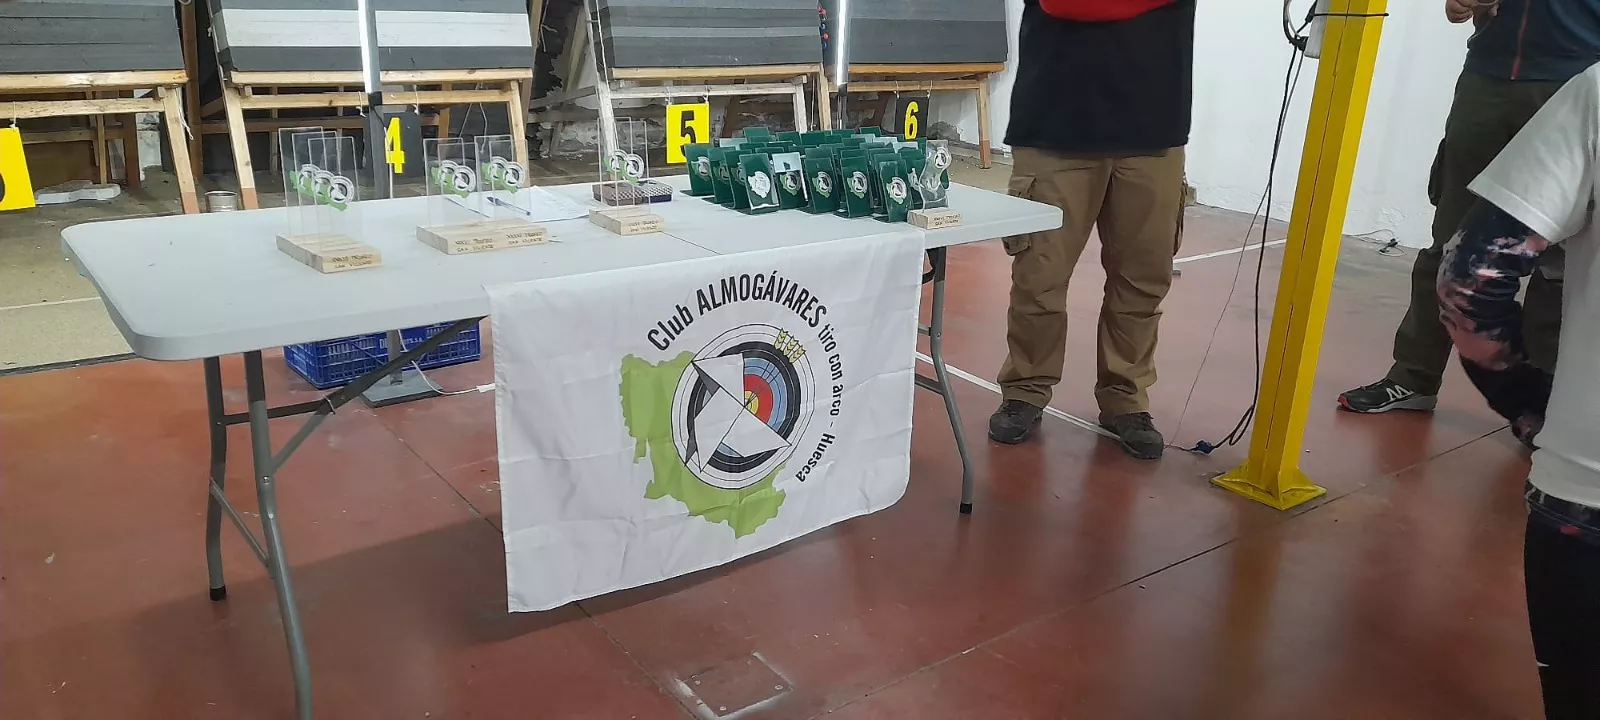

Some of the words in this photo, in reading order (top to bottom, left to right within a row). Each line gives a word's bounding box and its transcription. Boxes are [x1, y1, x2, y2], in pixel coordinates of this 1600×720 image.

[680, 110, 697, 157] 5
[904, 101, 919, 140] 6
[385, 117, 405, 173] 4
[696, 270, 827, 328] ALMOGÁVARES
[647, 304, 694, 351] Club
[818, 323, 837, 353] tiro
[828, 353, 843, 381] con
[829, 384, 844, 416] arco
[795, 433, 835, 482] Huesca
